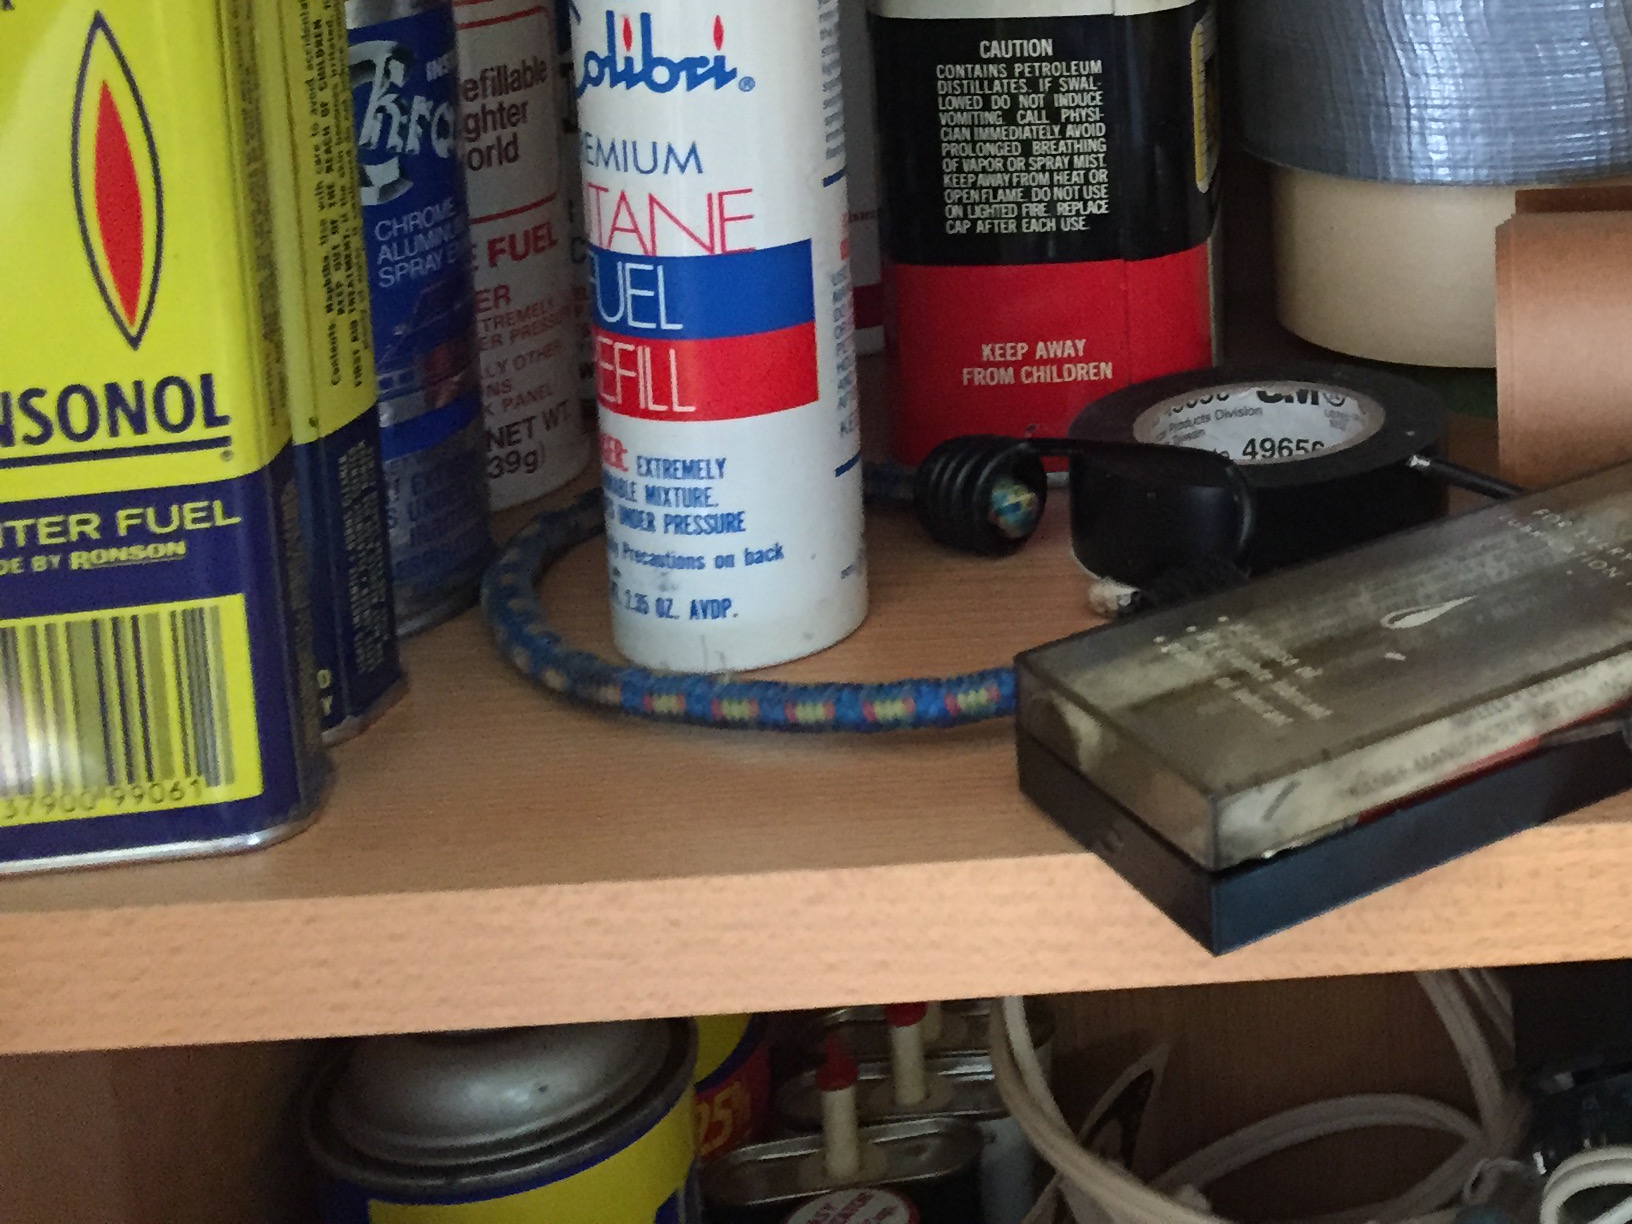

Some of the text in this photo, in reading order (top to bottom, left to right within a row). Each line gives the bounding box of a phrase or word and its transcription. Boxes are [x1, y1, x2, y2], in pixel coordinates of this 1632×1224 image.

[574, 10, 737, 99] olibri
[979, 38, 1053, 59] CAUTION
[462, 55, 547, 102] efillable
[936, 59, 1103, 79] CONTAINS PETROLEUM
[937, 76, 1102, 95] DISTILLATES. IF SWAL-
[938, 91, 1104, 110] LOWED DO NOT INDUCE
[464, 100, 529, 142] ghter
[1016, 110, 1050, 124] CALL
[1061, 107, 1105, 122] PHYSI-
[940, 127, 971, 141] CIAN
[1065, 122, 1106, 138] AVOID
[467, 132, 520, 171] orld
[581, 139, 703, 175] EMIUM
[941, 138, 1107, 157] PROLONGED BREATHING
[942, 158, 959, 172] OF
[962, 158, 1004, 172] VAPOR
[1007, 157, 1026, 171] OR
[1029, 155, 1070, 171] SPRAY
[943, 169, 1108, 188] KEEP AWAY FROM HEAT OR
[944, 189, 979, 203] OPEN
[1031, 187, 1051, 201] DO
[1053, 186, 1081, 201] NOT
[1083, 184, 1109, 199] USE
[945, 204, 963, 219] ON
[967, 203, 1018, 218] LIGHTED
[1057, 200, 1110, 216] REPLACE
[946, 220, 971, 234] CAP
[976, 219, 1017, 233] AFTER
[1022, 218, 1056, 232] EACH
[487, 221, 559, 267] FUEL
[378, 248, 443, 287] SPRAY
[982, 339, 1086, 362] KEEP AWAY
[962, 362, 1113, 386] FROM CHILDREN
[636, 455, 727, 480] EXTREMELY
[0, 500, 242, 549] TER FUEL
[664, 510, 746, 535] PRESSURE
[31, 554, 61, 572] BY
[69, 540, 187, 570] RONSON
[714, 553, 735, 569] on
[743, 542, 785, 566] back
